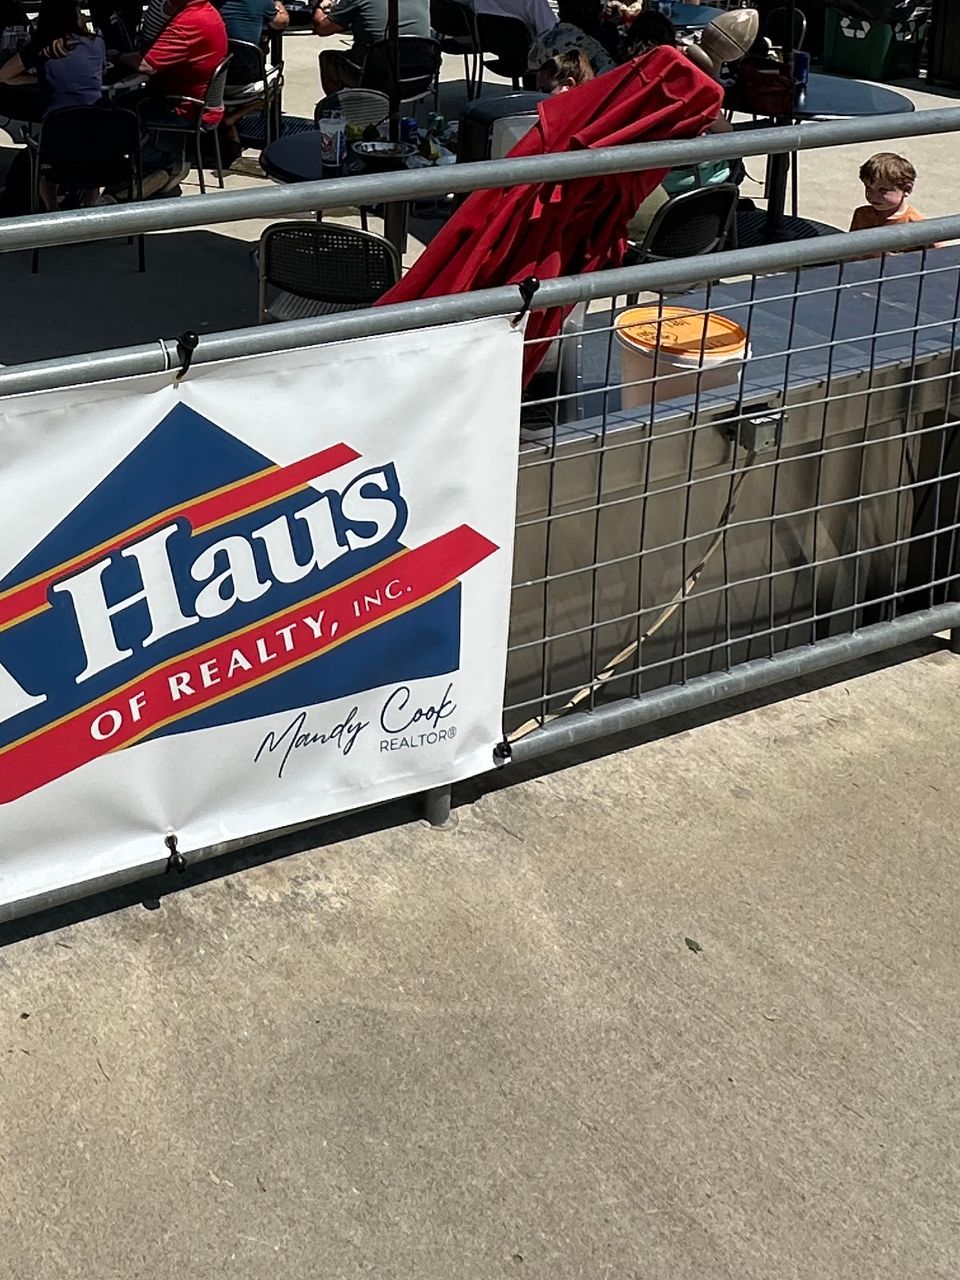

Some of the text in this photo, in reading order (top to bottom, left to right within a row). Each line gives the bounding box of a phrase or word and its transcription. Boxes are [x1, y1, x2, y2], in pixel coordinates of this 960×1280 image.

[52, 471, 399, 685] Haus
[89, 578, 413, 742] OF REALTY, INC.
[254, 682, 458, 779] Mandy Cook
